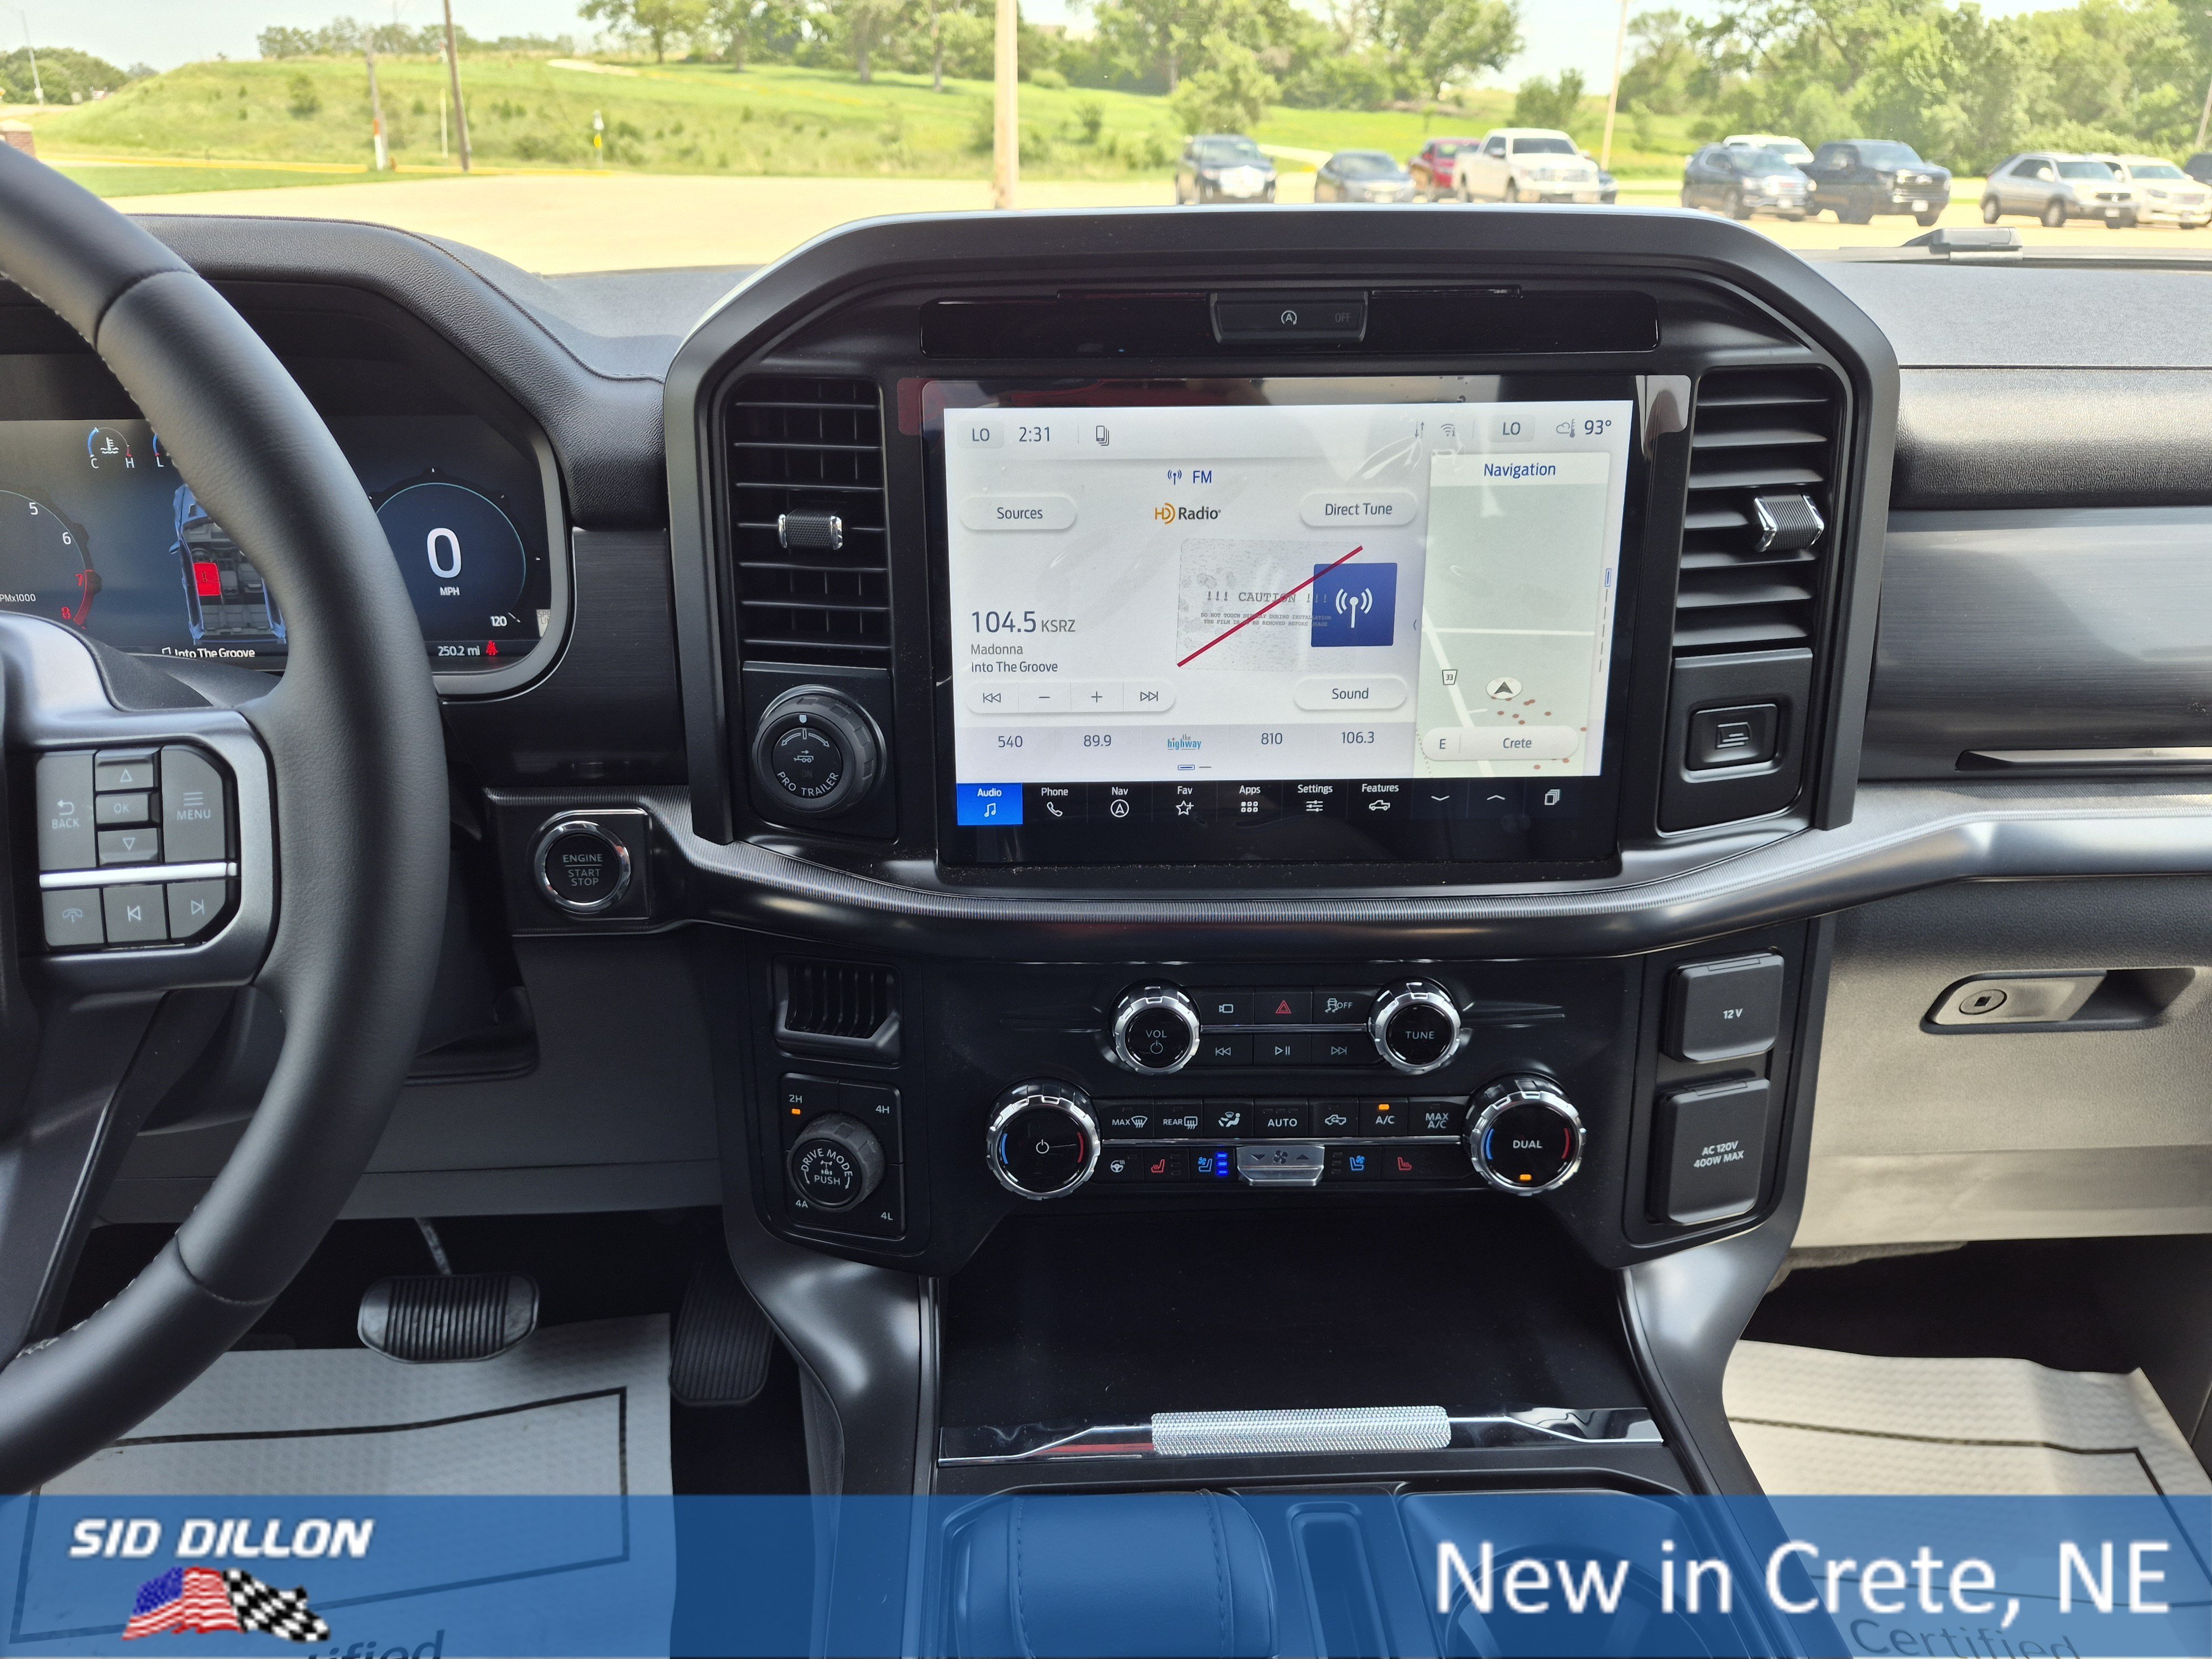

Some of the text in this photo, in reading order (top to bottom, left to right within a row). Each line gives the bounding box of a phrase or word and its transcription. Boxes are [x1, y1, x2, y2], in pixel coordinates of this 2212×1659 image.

[1335, 313, 1351, 322] OFF
[972, 426, 1051, 442] LO 2:31
[1503, 420, 1612, 436] LO 93°
[91, 458, 100, 469] C
[125, 457, 135, 468] H
[156, 456, 164, 467] L
[1483, 463, 1556, 478] Navigation
[1192, 470, 1212, 484] FM
[29, 502, 39, 515] 5
[997, 507, 1043, 520] Sources
[1178, 505, 1219, 520] Radio
[1325, 503, 1392, 517] Direct Tune
[62, 531, 72, 545] 6
[427, 528, 461, 578] 0
[75, 573, 83, 587] 7
[440, 586, 460, 597] MPH
[1238, 592, 1296, 603] CAUTION
[61, 607, 72, 619] 8
[490, 615, 508, 627] 120
[971, 611, 1076, 633] 104.5 KSRZ
[174, 648, 255, 658] Into The Groove
[437, 645, 481, 657] 250.2 mi
[971, 643, 1024, 655] Madonna
[971, 661, 1058, 673] Into The Groove
[1332, 687, 1369, 701] Sound
[998, 735, 1023, 749] 540
[1083, 734, 1112, 748] 89.9
[1261, 732, 1284, 745] 810
[1341, 731, 1375, 744] 106.3
[1503, 737, 1532, 749] Crete
[1167, 738, 1202, 750] highway
[1439, 738, 1446, 750] E
[777, 771, 839, 797] PRO TRAILER
[1297, 784, 1333, 795] Settings
[1361, 782, 1400, 794] Features
[977, 787, 1003, 798] Audio
[1041, 786, 1068, 797] Phone
[1112, 786, 1129, 796] Nav
[1177, 785, 1193, 796] Fav
[1239, 785, 1261, 797] Apps
[113, 802, 130, 814] OK
[176, 808, 211, 821] MENU
[51, 817, 80, 830] BACK
[562, 854, 603, 863] ENGINE
[568, 868, 601, 878] START
[571, 877, 599, 886] STOP
[1723, 1008, 1744, 1020] 12 V
[1145, 1030, 1167, 1039] VOL
[1405, 1031, 1434, 1040] TUNE
[789, 1094, 802, 1103] 2H
[875, 1105, 890, 1114] 4H
[1375, 1115, 1395, 1125] A/C
[1425, 1112, 1449, 1121] MAX
[1267, 1118, 1298, 1128] AUTO
[1427, 1120, 1447, 1129] A/C
[1513, 1139, 1542, 1149] DUAL
[1702, 1140, 1739, 1156] AC 120V
[801, 1148, 853, 1177] DRIVE MODE
[1693, 1150, 1745, 1168] 400W MAX
[814, 1175, 841, 1185] PUSH
[795, 1199, 808, 1208] 4A
[880, 1212, 894, 1220] 4L
